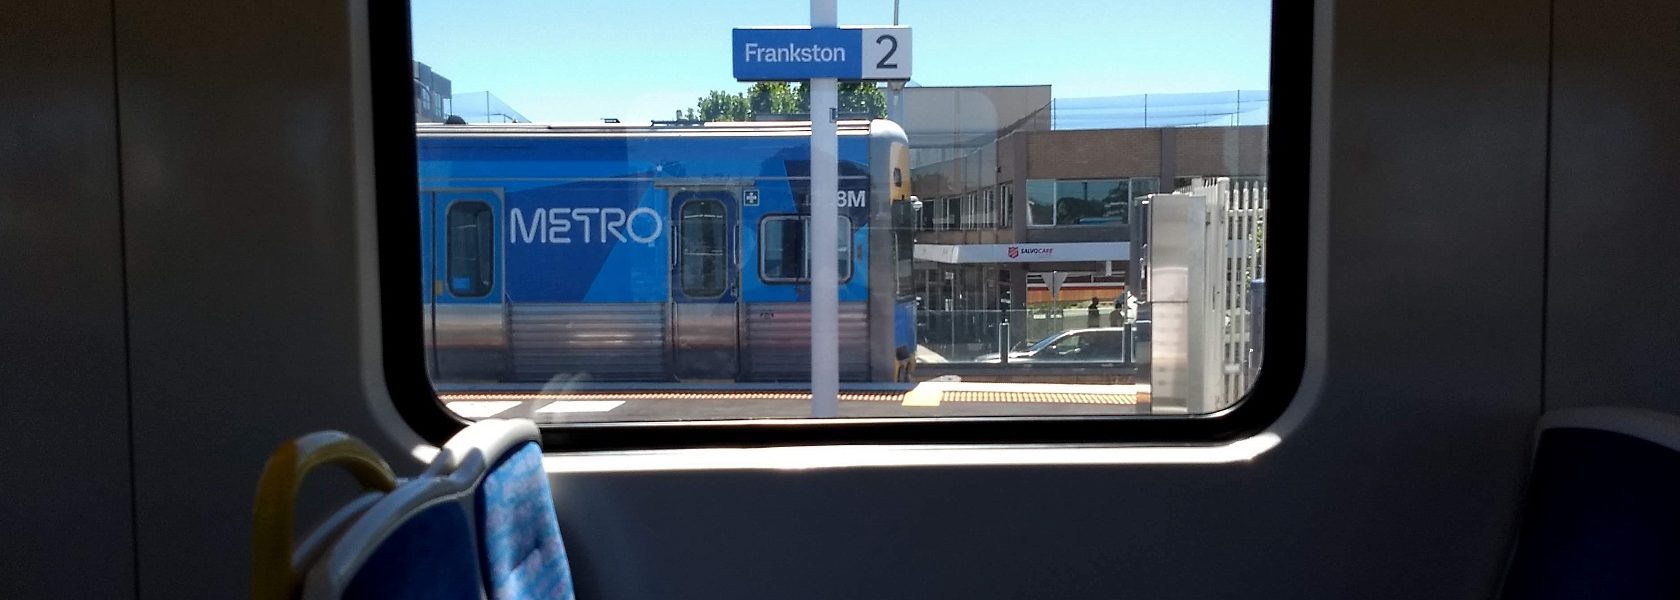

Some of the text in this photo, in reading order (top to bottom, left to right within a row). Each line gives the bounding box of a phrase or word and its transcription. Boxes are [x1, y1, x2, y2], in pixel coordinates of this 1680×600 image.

[745, 34, 898, 69] Frankston 2
[510, 207, 663, 243] METRO
